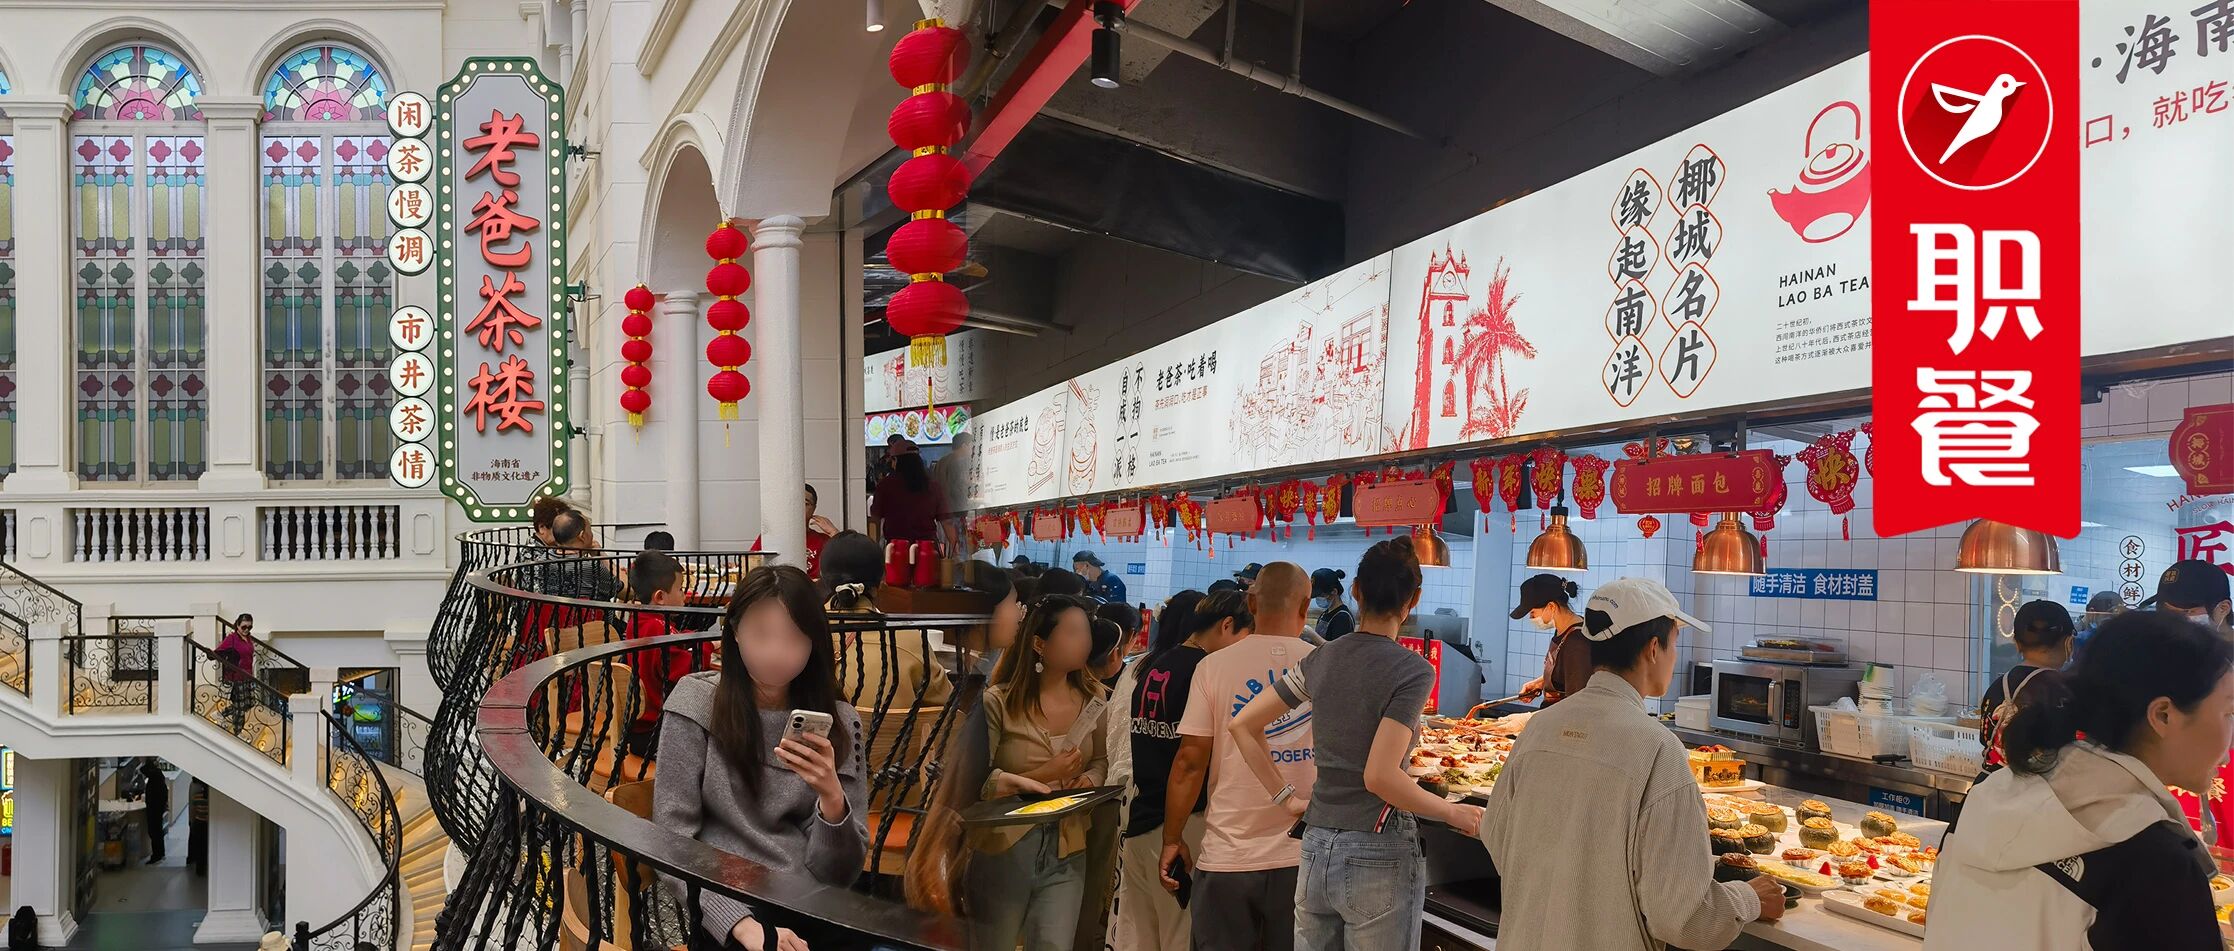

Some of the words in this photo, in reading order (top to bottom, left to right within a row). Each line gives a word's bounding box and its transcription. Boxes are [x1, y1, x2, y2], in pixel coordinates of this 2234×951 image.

[2085, 80, 2234, 148] 口，就吃
[396, 101, 424, 265] 闲茶慢调
[463, 108, 545, 434] 老爸茶楼
[1610, 179, 1653, 396] 缘起南洋
[1670, 155, 1717, 385] 椰城名片
[1778, 290, 1807, 308] LAO
[1813, 285, 1833, 300] BA
[1840, 276, 1870, 294] TEA
[1779, 263, 1836, 288] HAINAN
[1775, 329, 1872, 353] 上世纪八十年代后，西式茶店经
[397, 314, 427, 480] 市井茶情
[472, 470, 540, 481] 非物质文化遗产
[490, 459, 520, 469] 海南省
[1646, 471, 1730, 497] 招牌面包
[1753, 573, 1807, 594] 随手清洁
[1813, 573, 1874, 597] 食材封盖
[2122, 539, 2141, 602] 食材鲜
